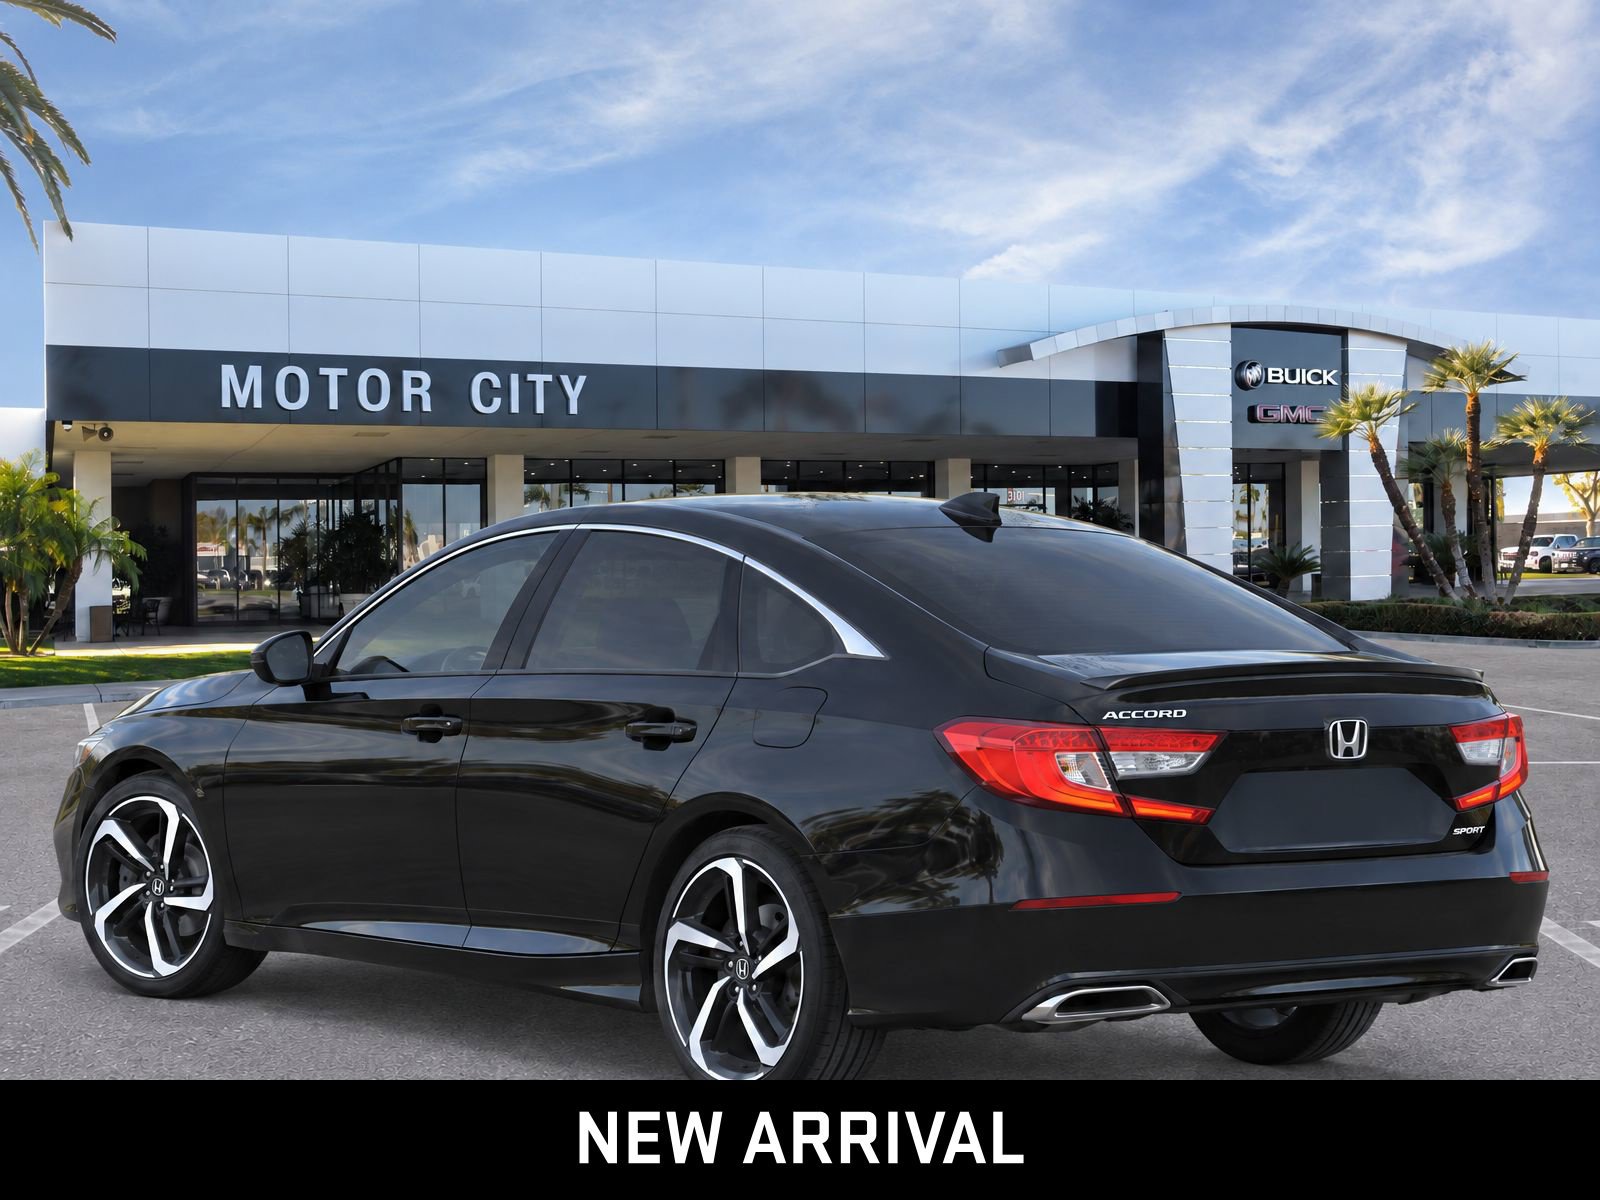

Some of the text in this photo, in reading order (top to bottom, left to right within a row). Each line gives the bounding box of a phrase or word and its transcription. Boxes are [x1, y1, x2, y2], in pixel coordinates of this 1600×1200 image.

[1267, 367, 1339, 386] BUICK
[221, 364, 587, 416] MOTOR CITY
[1256, 403, 1328, 424] GMC
[1102, 709, 1187, 720] ACCORD
[1453, 826, 1486, 836] SPORT
